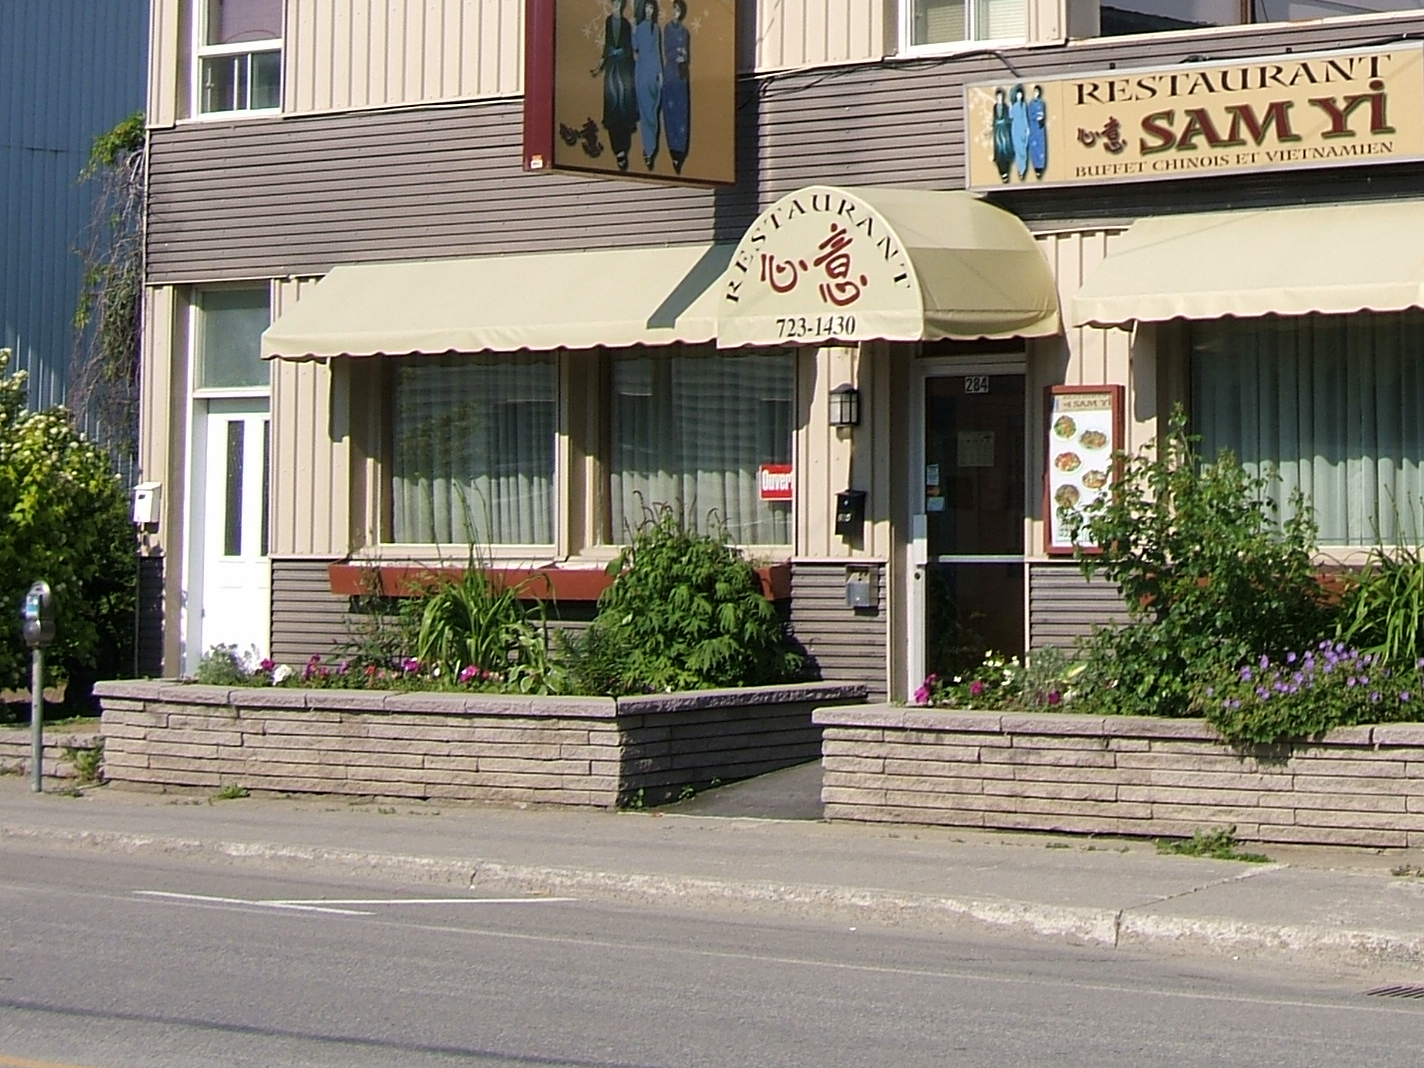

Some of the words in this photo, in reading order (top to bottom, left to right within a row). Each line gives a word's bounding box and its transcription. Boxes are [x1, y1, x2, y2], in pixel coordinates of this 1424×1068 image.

[1073, 53, 1392, 106] RESTAURANT
[1139, 100, 1300, 156] SAM
[1074, 160, 1148, 179] BUFFET
[1152, 154, 1230, 172] CHINOIS
[1235, 151, 1262, 166] ET
[1266, 140, 1394, 163] VIETNAMIEN
[725, 193, 912, 305] RESTAURANT
[776, 314, 856, 339] 723-1430
[966, 377, 988, 392] 284
